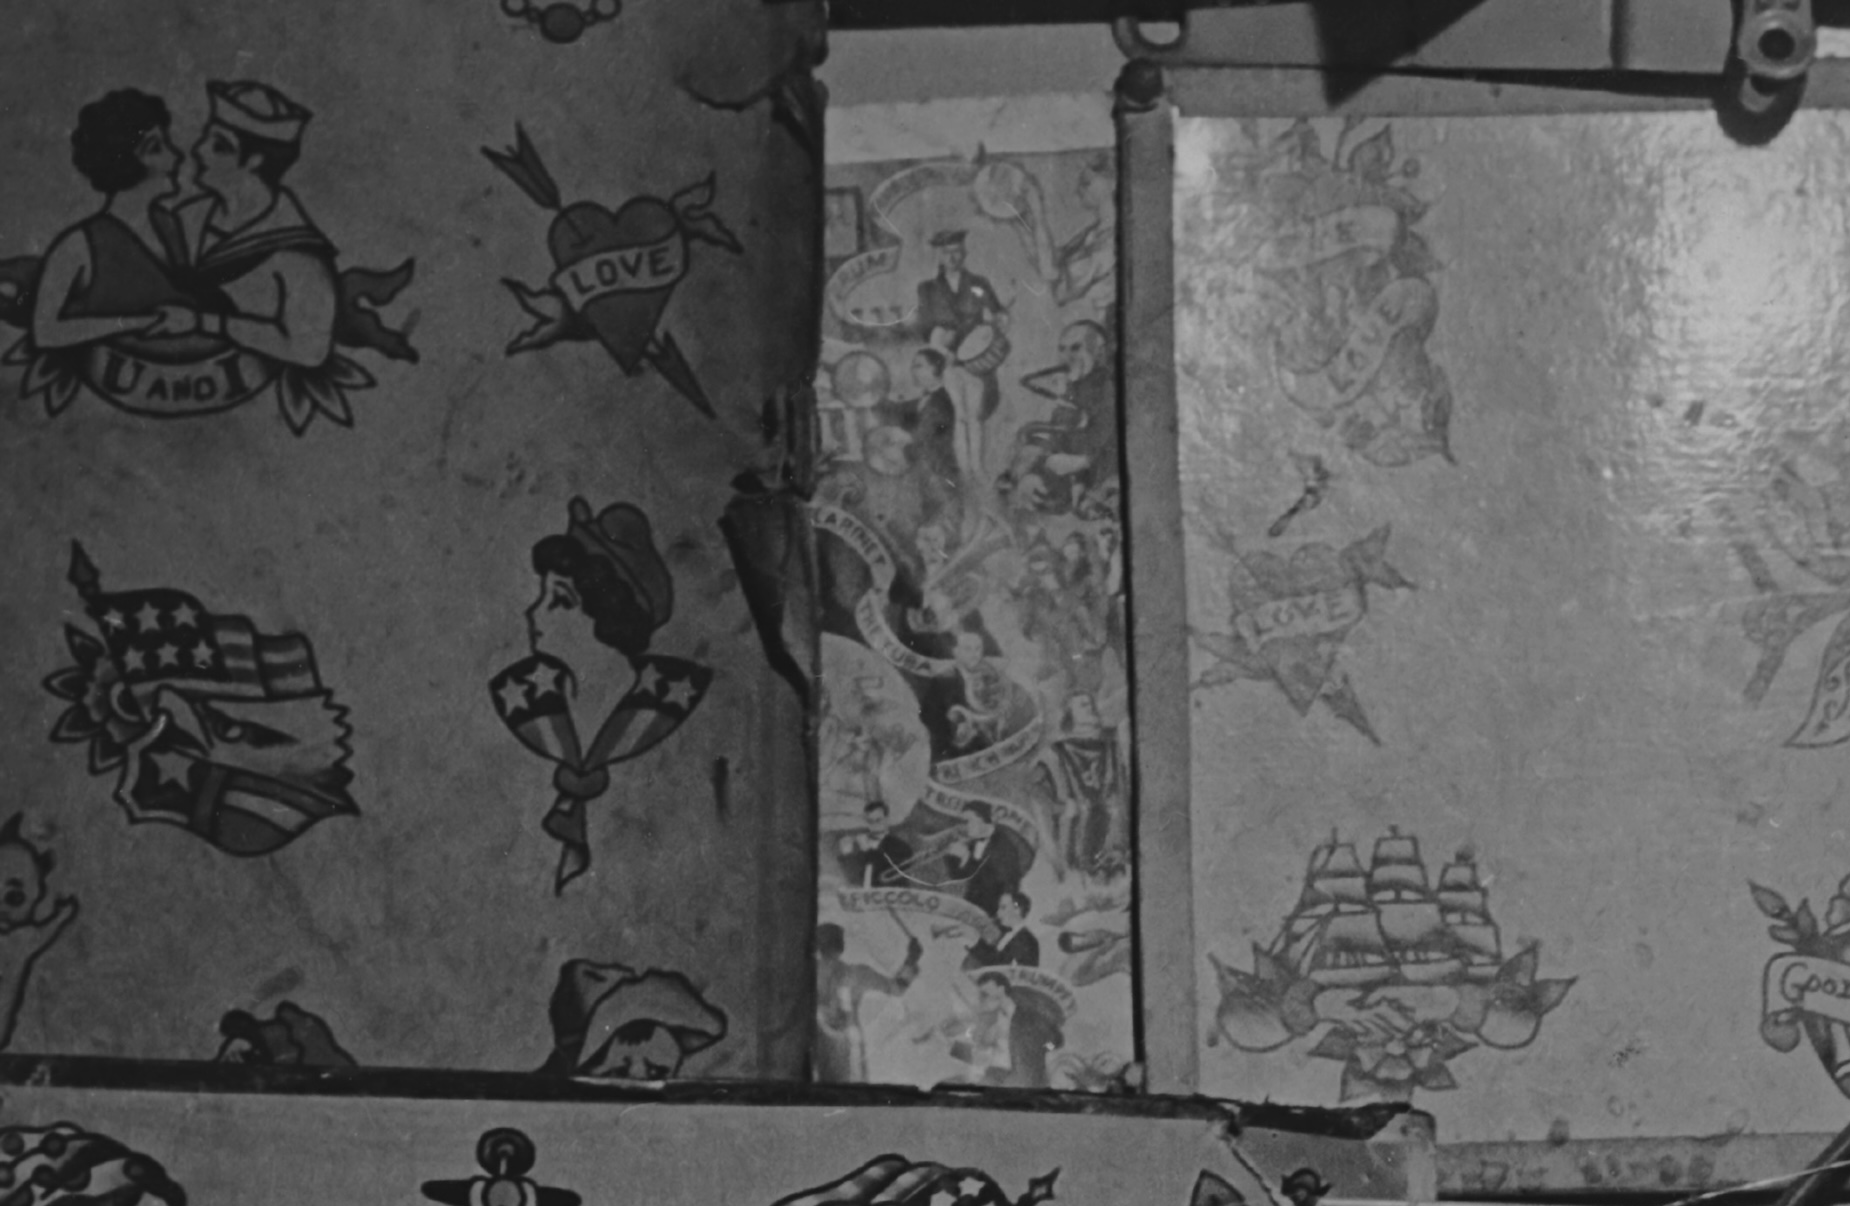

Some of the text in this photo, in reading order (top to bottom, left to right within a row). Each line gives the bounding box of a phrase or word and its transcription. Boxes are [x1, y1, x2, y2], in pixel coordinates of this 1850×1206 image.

[569, 246, 676, 295] LOVE
[102, 352, 252, 402] U AND I
